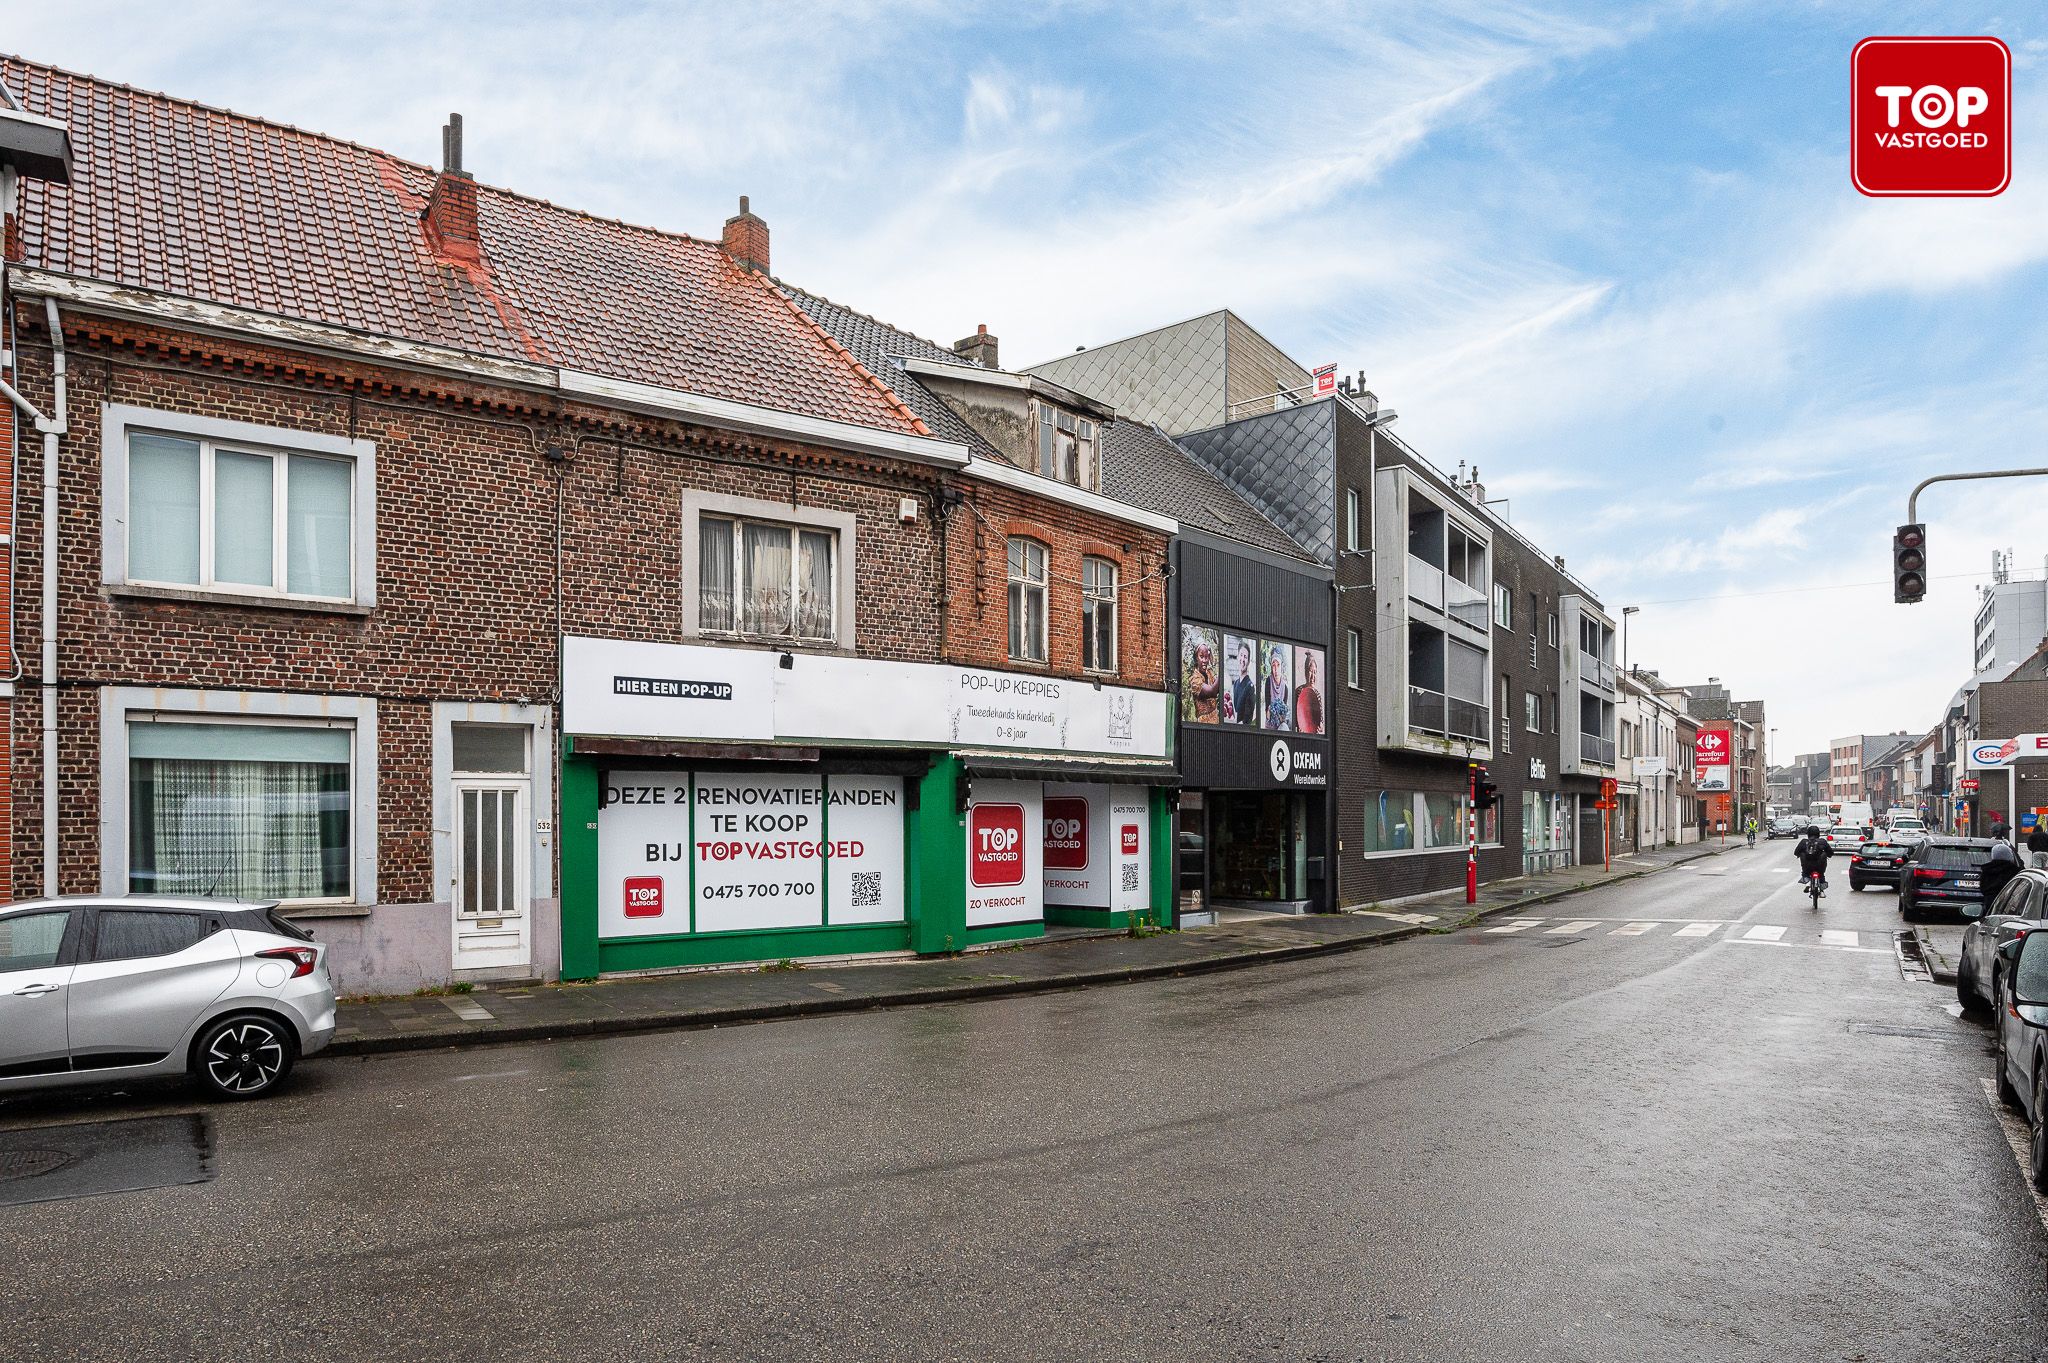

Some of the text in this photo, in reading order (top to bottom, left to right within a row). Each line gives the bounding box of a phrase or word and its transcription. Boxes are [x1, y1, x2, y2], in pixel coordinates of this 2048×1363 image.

[616, 679, 731, 697] HIER EEN POP-UP
[961, 673, 1060, 699] POP-UP KEPPIES
[966, 704, 1015, 720] Tweedehands
[996, 726, 1028, 741] 0-8 jaar
[1293, 751, 1321, 770] OXFAM
[607, 786, 666, 805] DEZE
[673, 787, 686, 805] 2
[1113, 806, 1146, 814] 0475 700 700
[537, 822, 551, 830] 532
[710, 814, 809, 833] TE KOOP
[1044, 818, 1081, 839] TOP
[978, 827, 1019, 851] TOP
[1044, 840, 1081, 849] ASTGOED
[1123, 833, 1137, 843] TOP
[646, 843, 682, 862] BIJ
[978, 852, 1018, 862] VASTGOED
[703, 882, 815, 900] 0475 700 700
[1044, 880, 1090, 889] VERKOCHT
[629, 888, 659, 901] TOP
[970, 896, 1026, 909] ZO VERKOCHT
